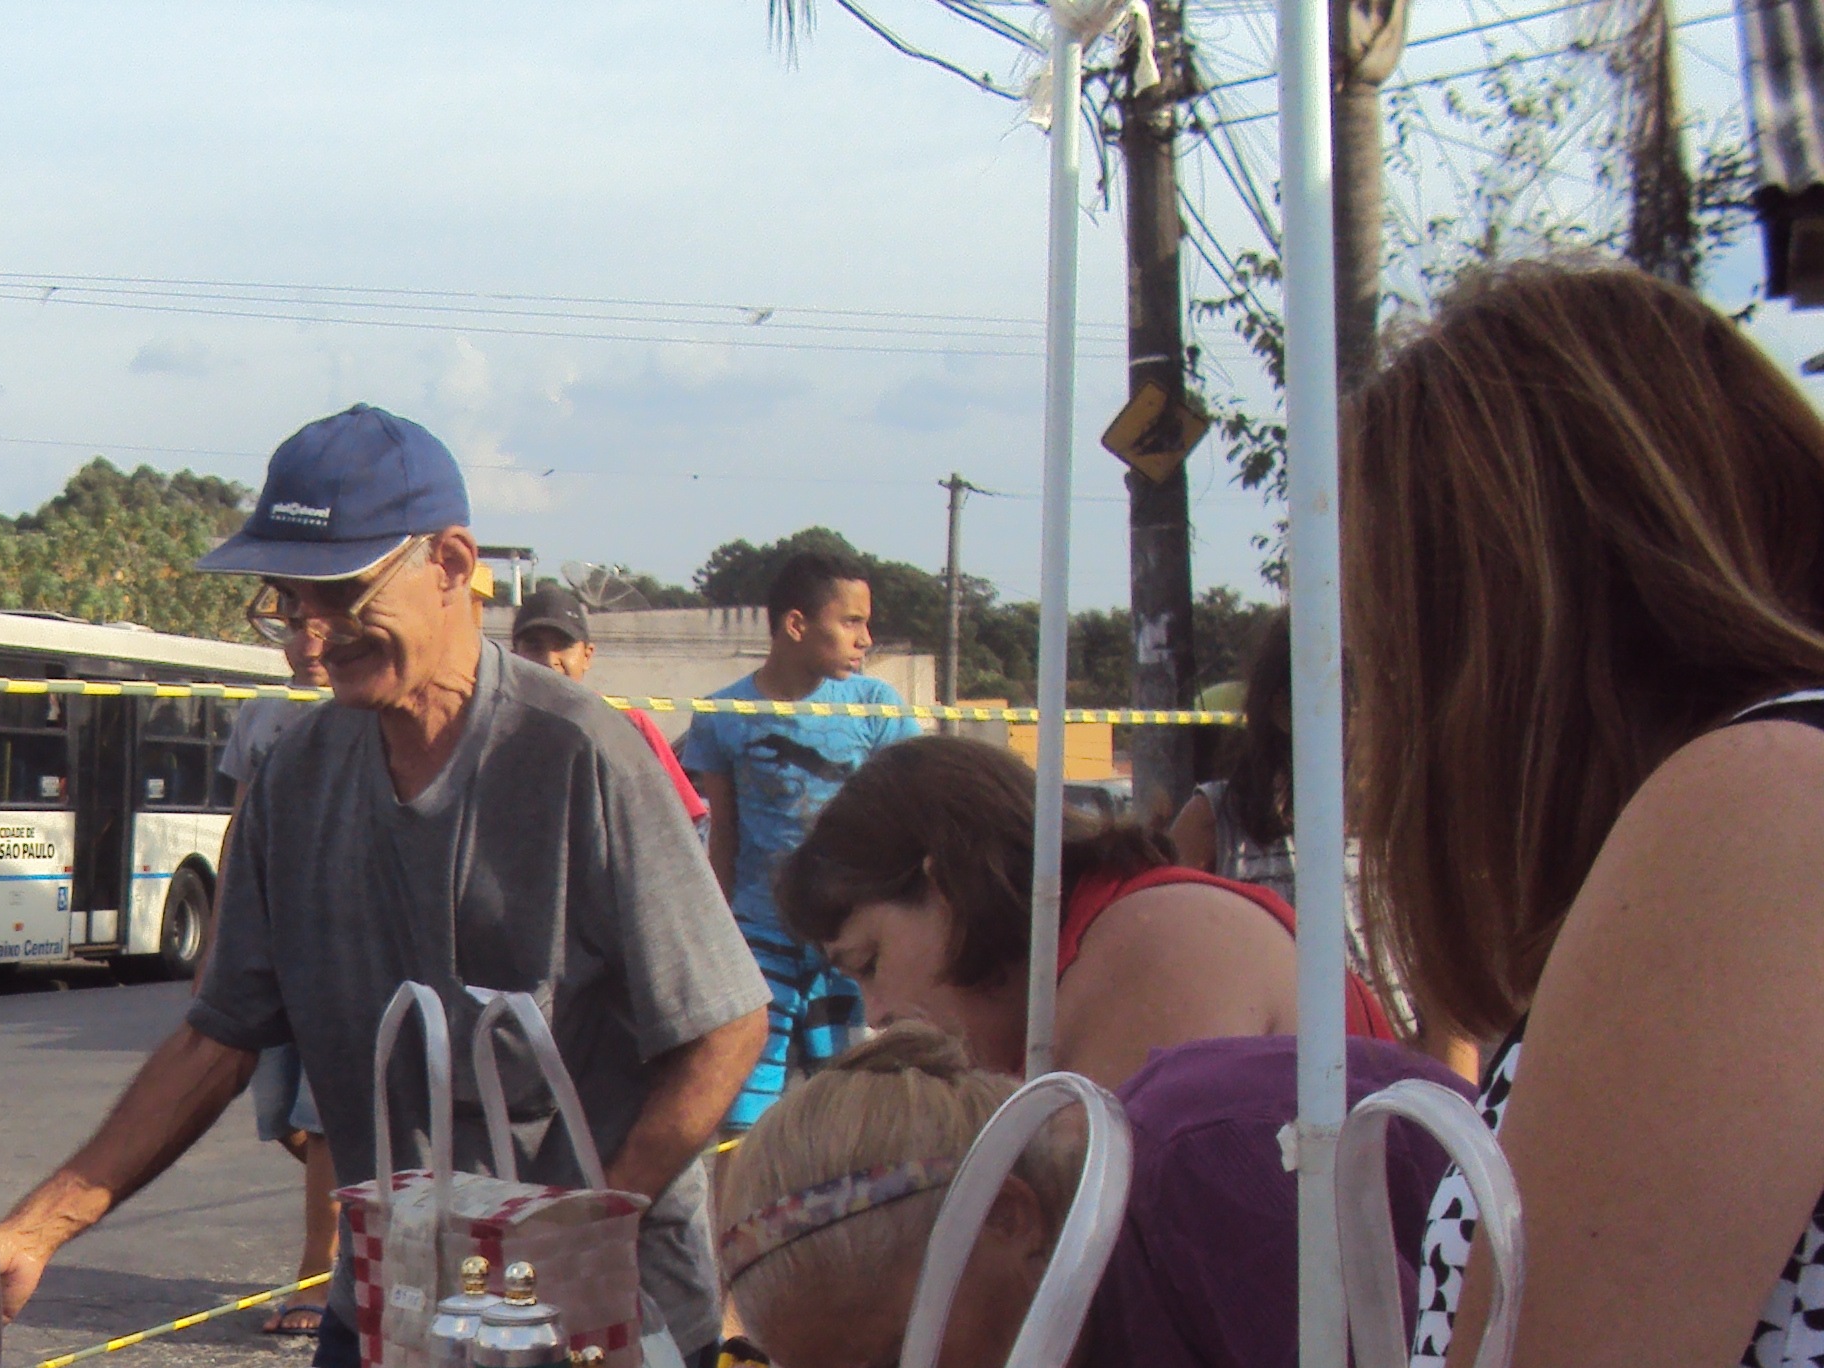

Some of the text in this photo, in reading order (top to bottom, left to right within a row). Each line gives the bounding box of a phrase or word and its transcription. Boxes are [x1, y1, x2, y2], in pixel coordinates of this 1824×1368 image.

[0, 827, 35, 838] CIDADE DE
[23, 843, 55, 860] PAULO
[23, 938, 64, 956] Central
